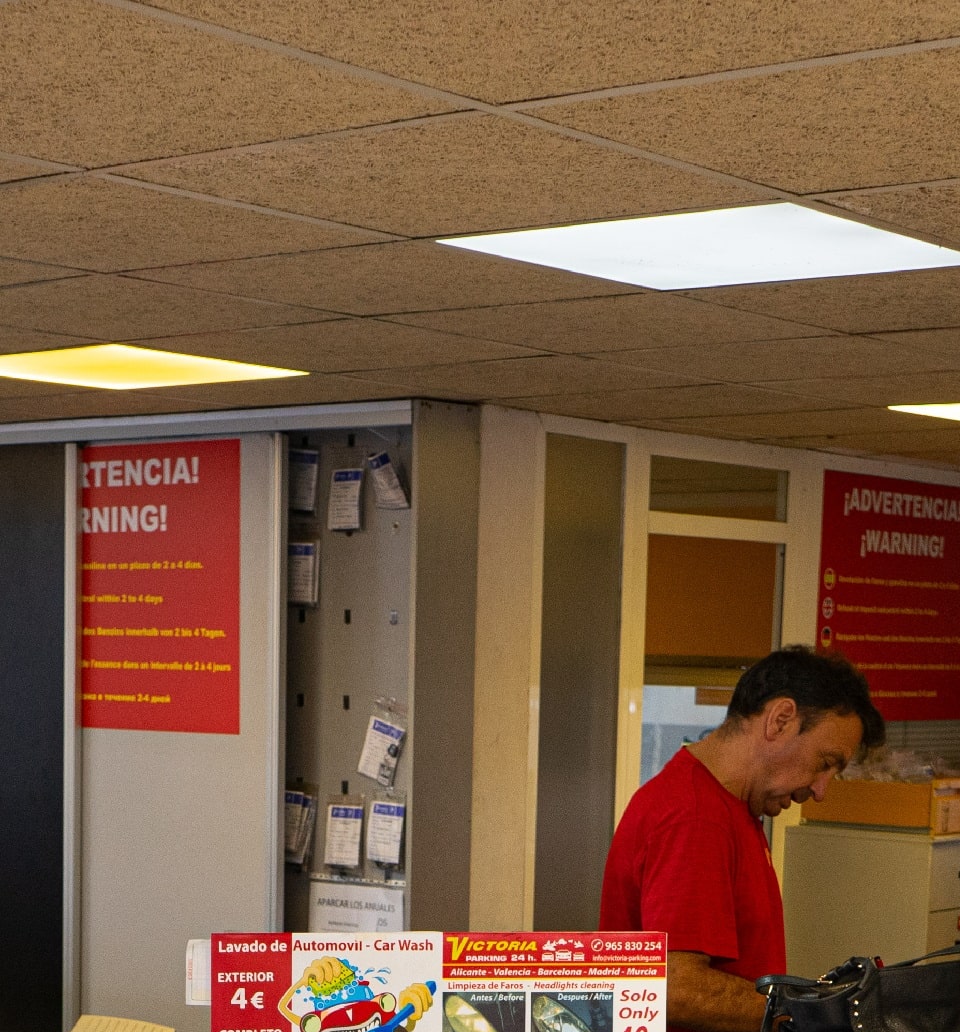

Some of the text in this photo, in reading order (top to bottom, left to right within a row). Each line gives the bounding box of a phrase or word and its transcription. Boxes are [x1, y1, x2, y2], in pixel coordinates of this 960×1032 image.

[860, 529, 945, 558] ¡WARNING!
[177, 560, 183, 569] 4
[138, 594, 144, 603] 4
[175, 628, 180, 638] 2
[194, 628, 200, 638] 4
[207, 661, 212, 672] 4
[218, 940, 267, 953] Lavado
[270, 939, 287, 953] de
[293, 939, 363, 952] Automovil
[374, 939, 396, 952] Car
[397, 939, 434, 952] Wash
[446, 937, 537, 961] VICTORIA
[605, 941, 662, 951] 965 830 254
[511, 954, 525, 962] 24
[528, 953, 537, 962] h.
[592, 954, 662, 963] info@victoria-parking.com
[450, 967, 487, 976] Alicante
[493, 967, 531, 976] Valencia
[537, 967, 582, 976] Barcelona
[588, 967, 620, 976] Madrid
[626, 967, 657, 976] Murcia
[217, 971, 274, 983] EXTERIOR
[448, 981, 486, 991] Limpieza
[488, 981, 499, 990] de
[500, 982, 524, 990] Faros
[533, 981, 578, 991] Headlights
[580, 981, 615, 991] cleaning
[470, 993, 493, 1001] Antes
[498, 993, 524, 1001] Before
[557, 992, 588, 1002] Despues
[593, 992, 613, 1001] After
[620, 989, 657, 1002] Solo
[619, 1006, 659, 1021] Only
